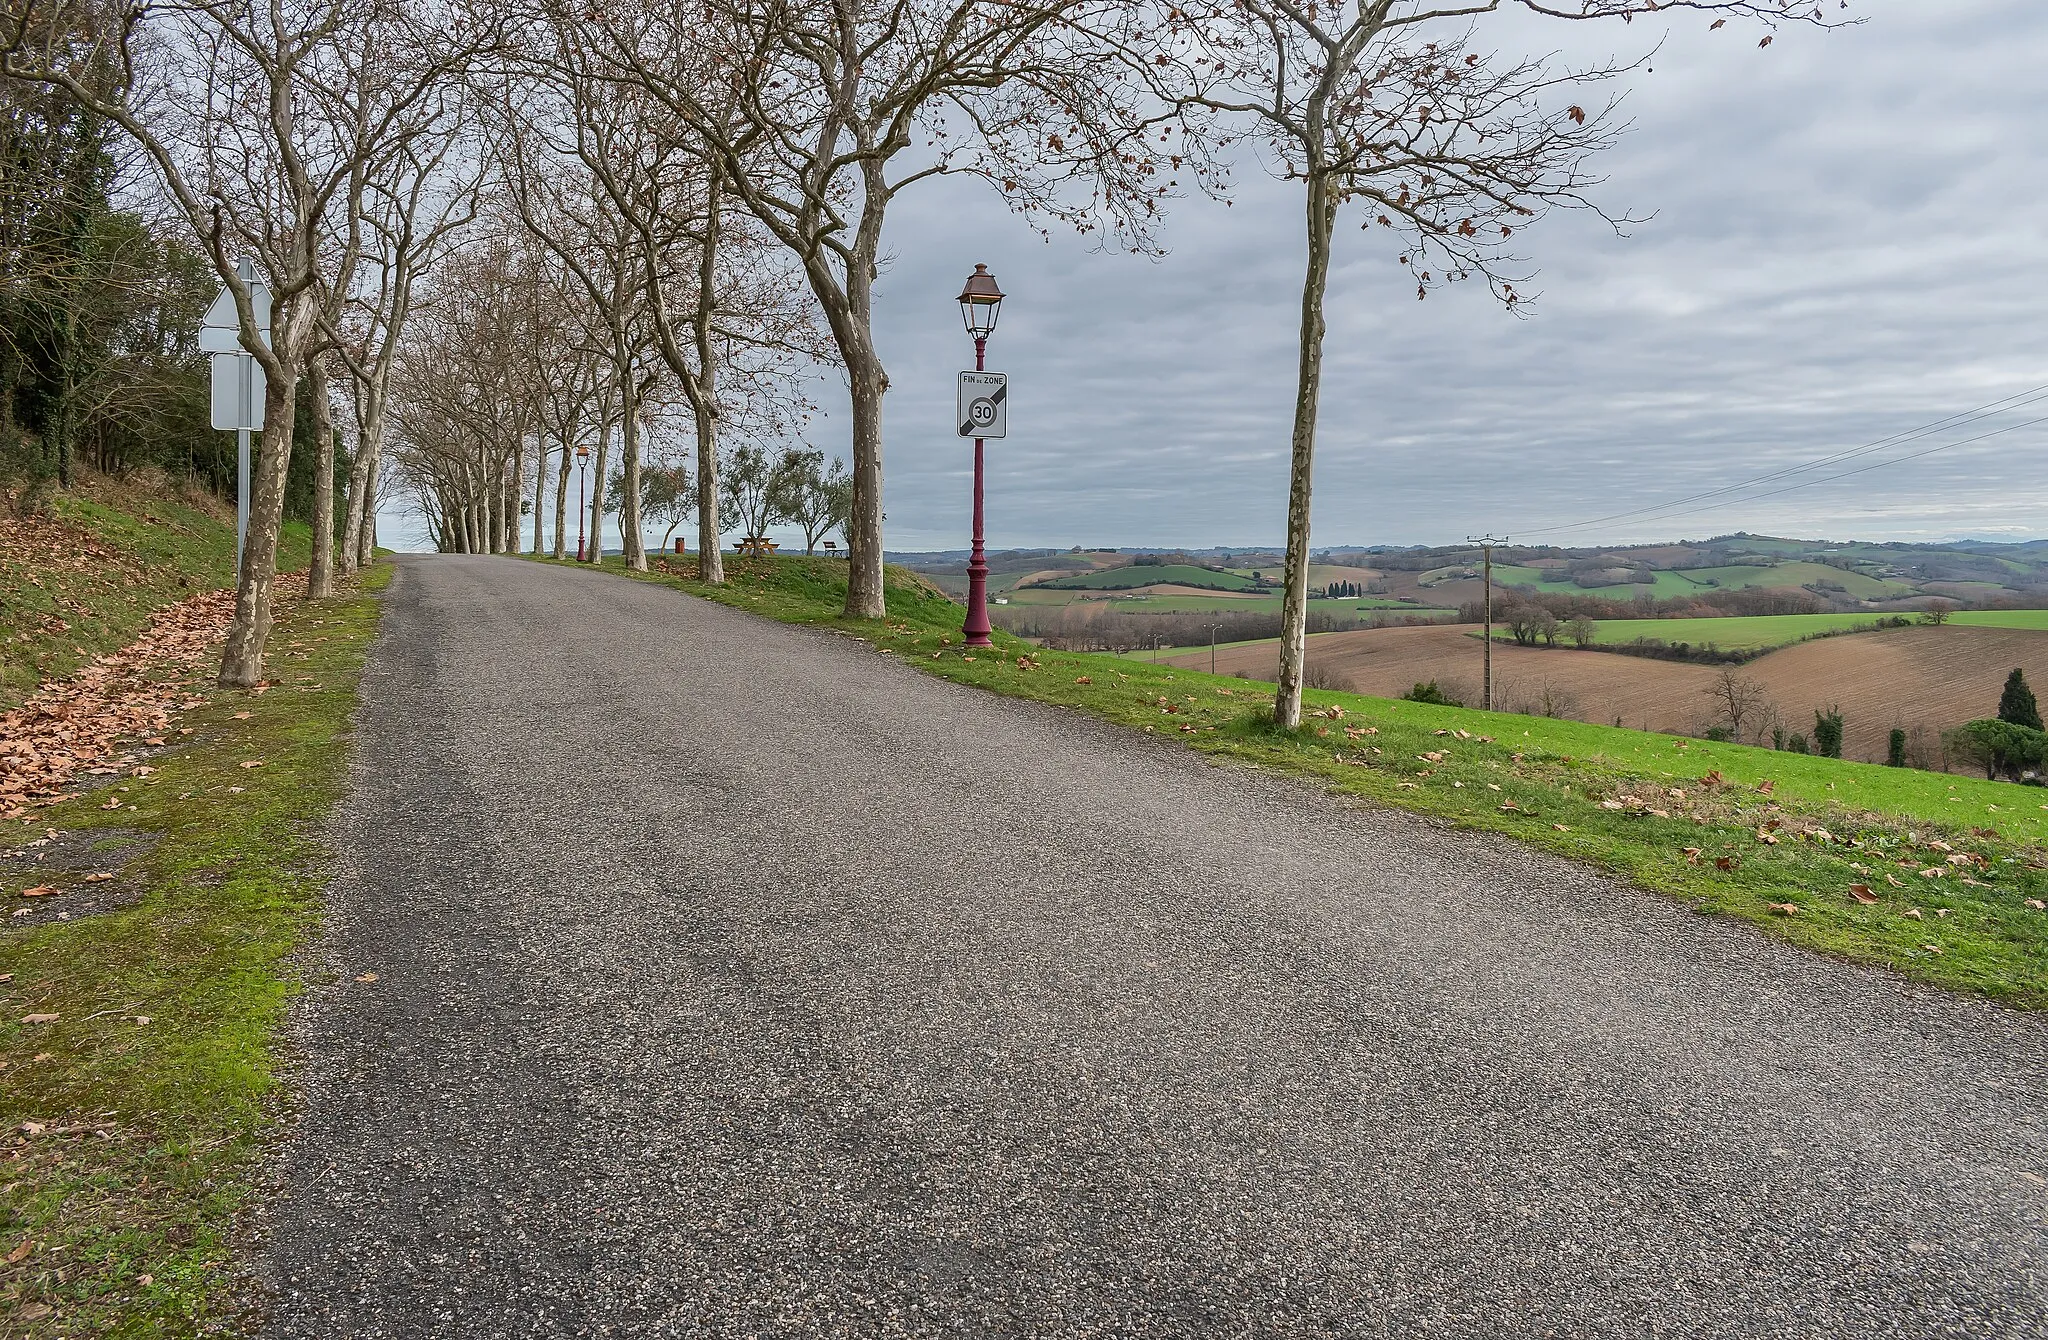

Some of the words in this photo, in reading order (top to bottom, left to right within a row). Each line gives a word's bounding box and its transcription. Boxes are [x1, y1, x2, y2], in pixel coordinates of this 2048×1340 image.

[963, 375, 976, 384] FIN
[984, 376, 1004, 385] ZONE
[974, 406, 992, 419] 30
